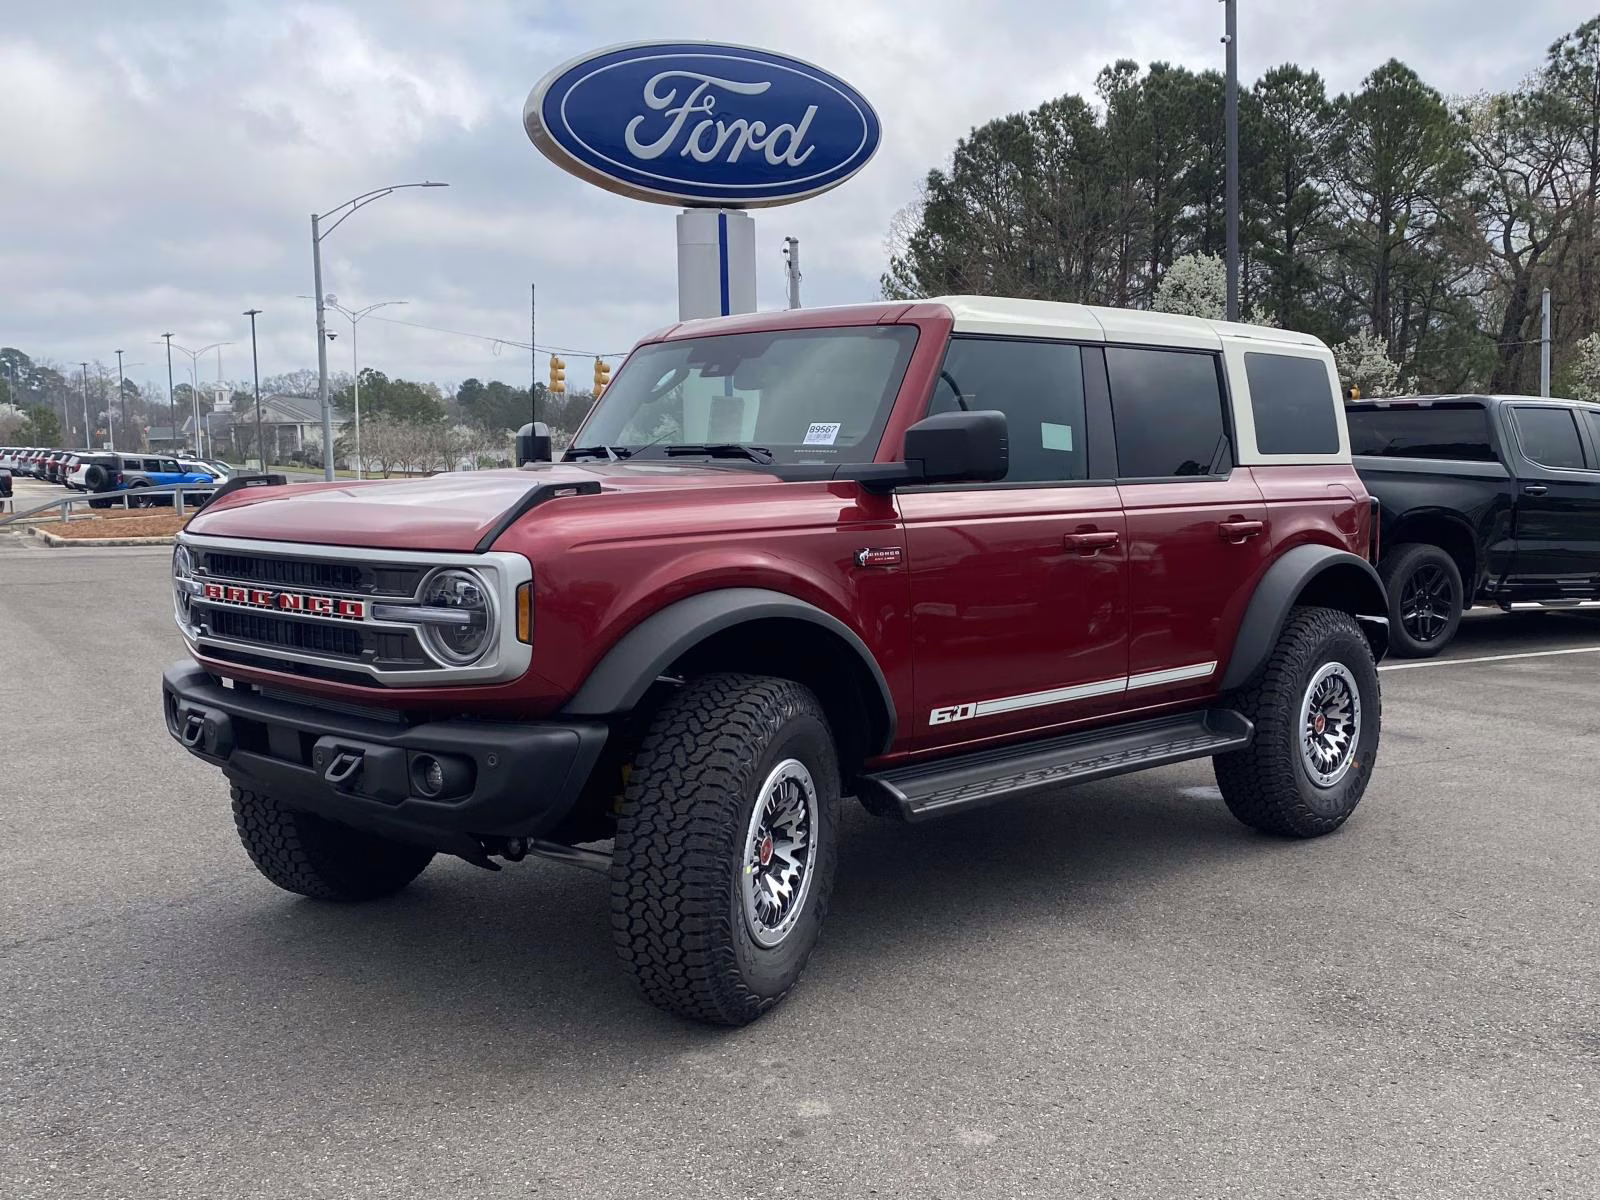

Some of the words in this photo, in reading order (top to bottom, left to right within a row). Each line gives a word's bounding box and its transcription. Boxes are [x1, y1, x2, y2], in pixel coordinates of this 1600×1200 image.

[625, 70, 818, 166] Ford
[204, 583, 365, 617] BRONCO
[928, 702, 977, 726] 60
